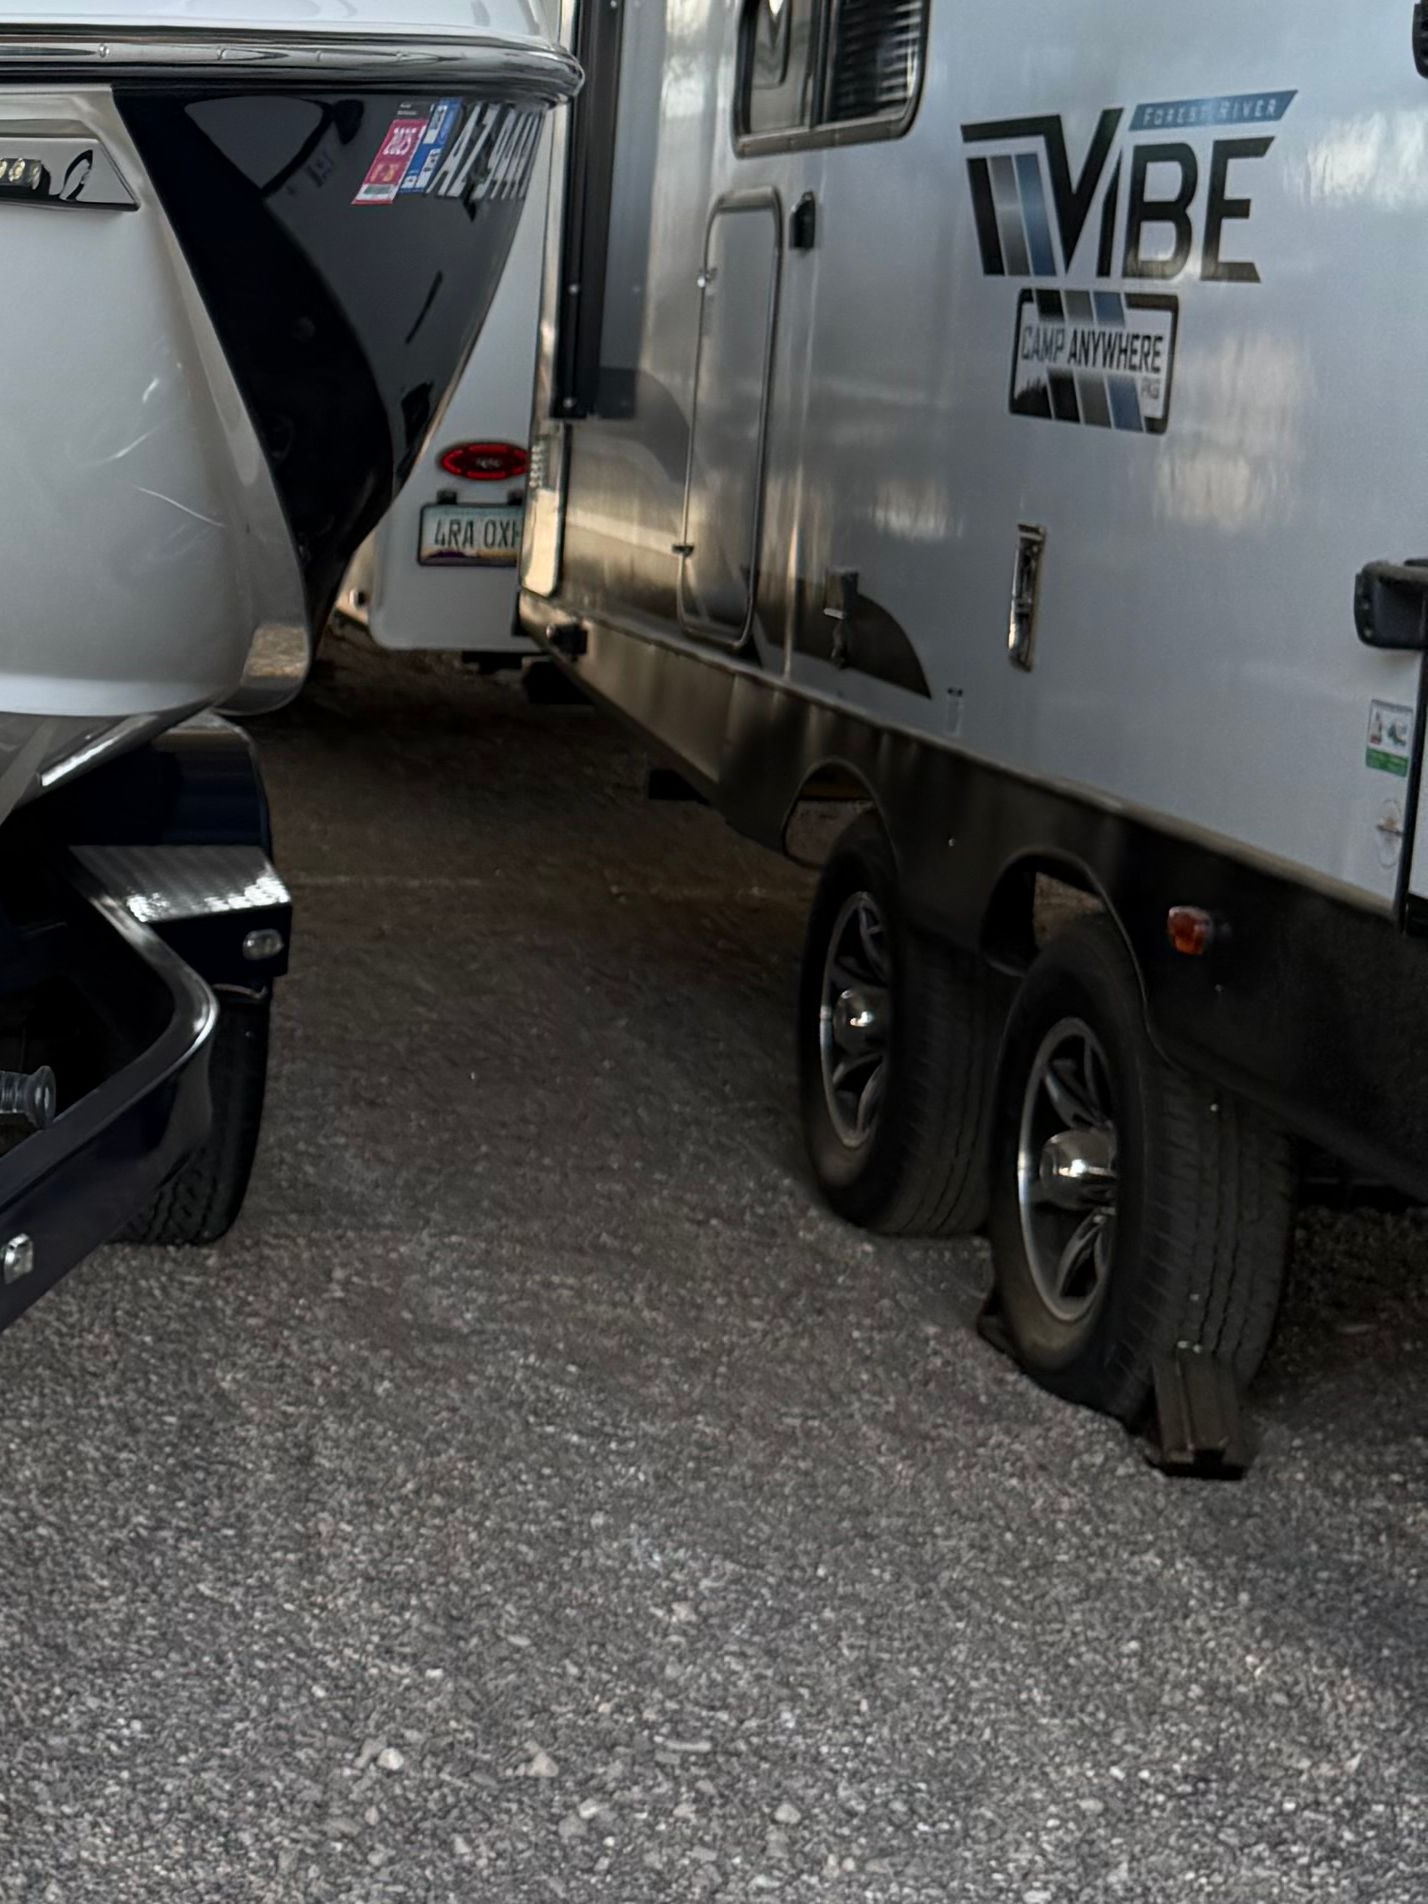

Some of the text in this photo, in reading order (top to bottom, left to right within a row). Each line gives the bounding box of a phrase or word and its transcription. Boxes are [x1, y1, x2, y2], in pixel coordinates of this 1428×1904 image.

[1219, 99, 1277, 119] RIVER
[426, 102, 501, 197] AZ
[960, 106, 1276, 284] VIBE
[1021, 325, 1164, 374] CAMP ANYWHERE
